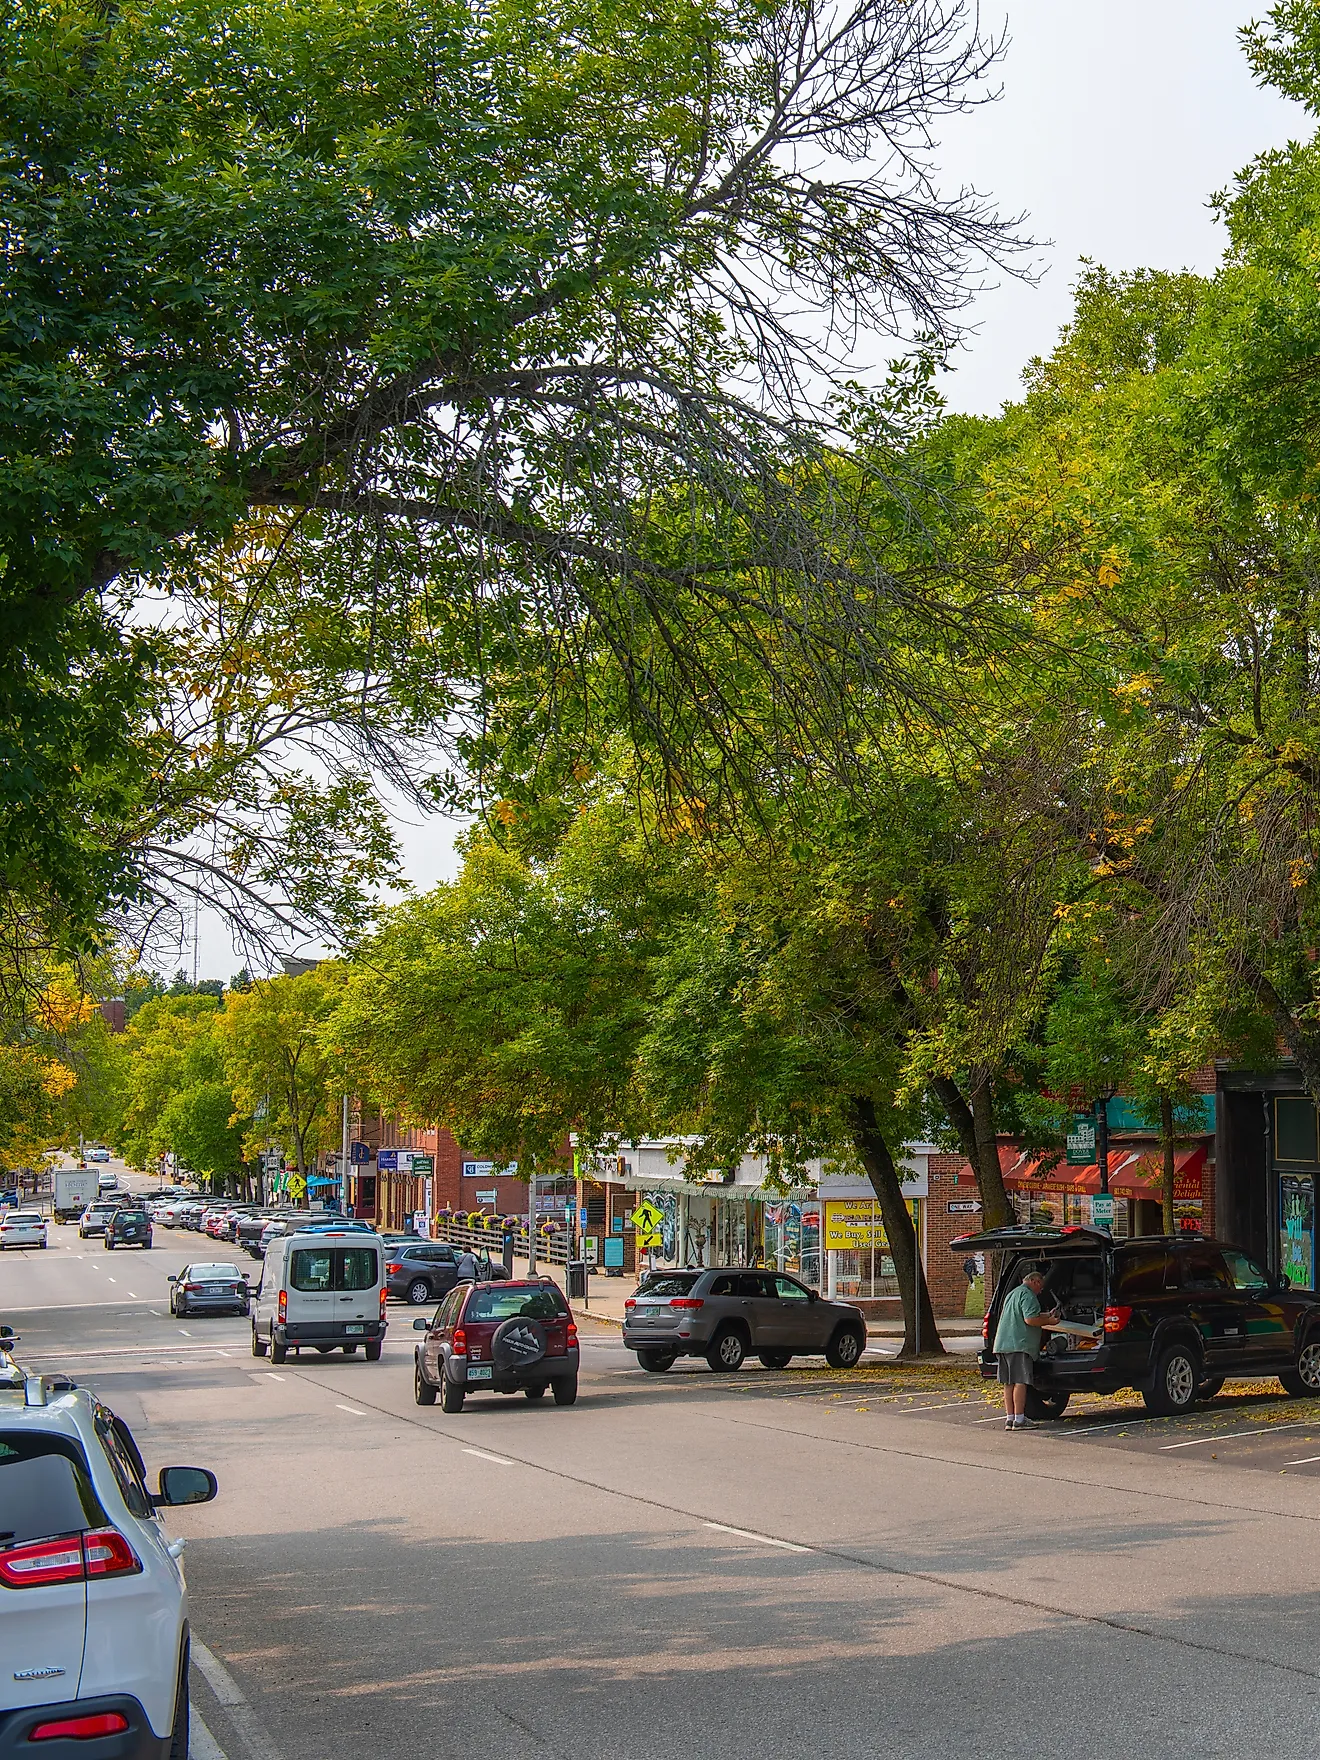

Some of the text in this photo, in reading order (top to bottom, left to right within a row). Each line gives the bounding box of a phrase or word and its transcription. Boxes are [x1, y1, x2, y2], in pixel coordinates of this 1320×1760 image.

[1180, 1218, 1202, 1230] OPEN
[829, 1231, 842, 1239] We
[845, 1231, 864, 1239] Buy,
